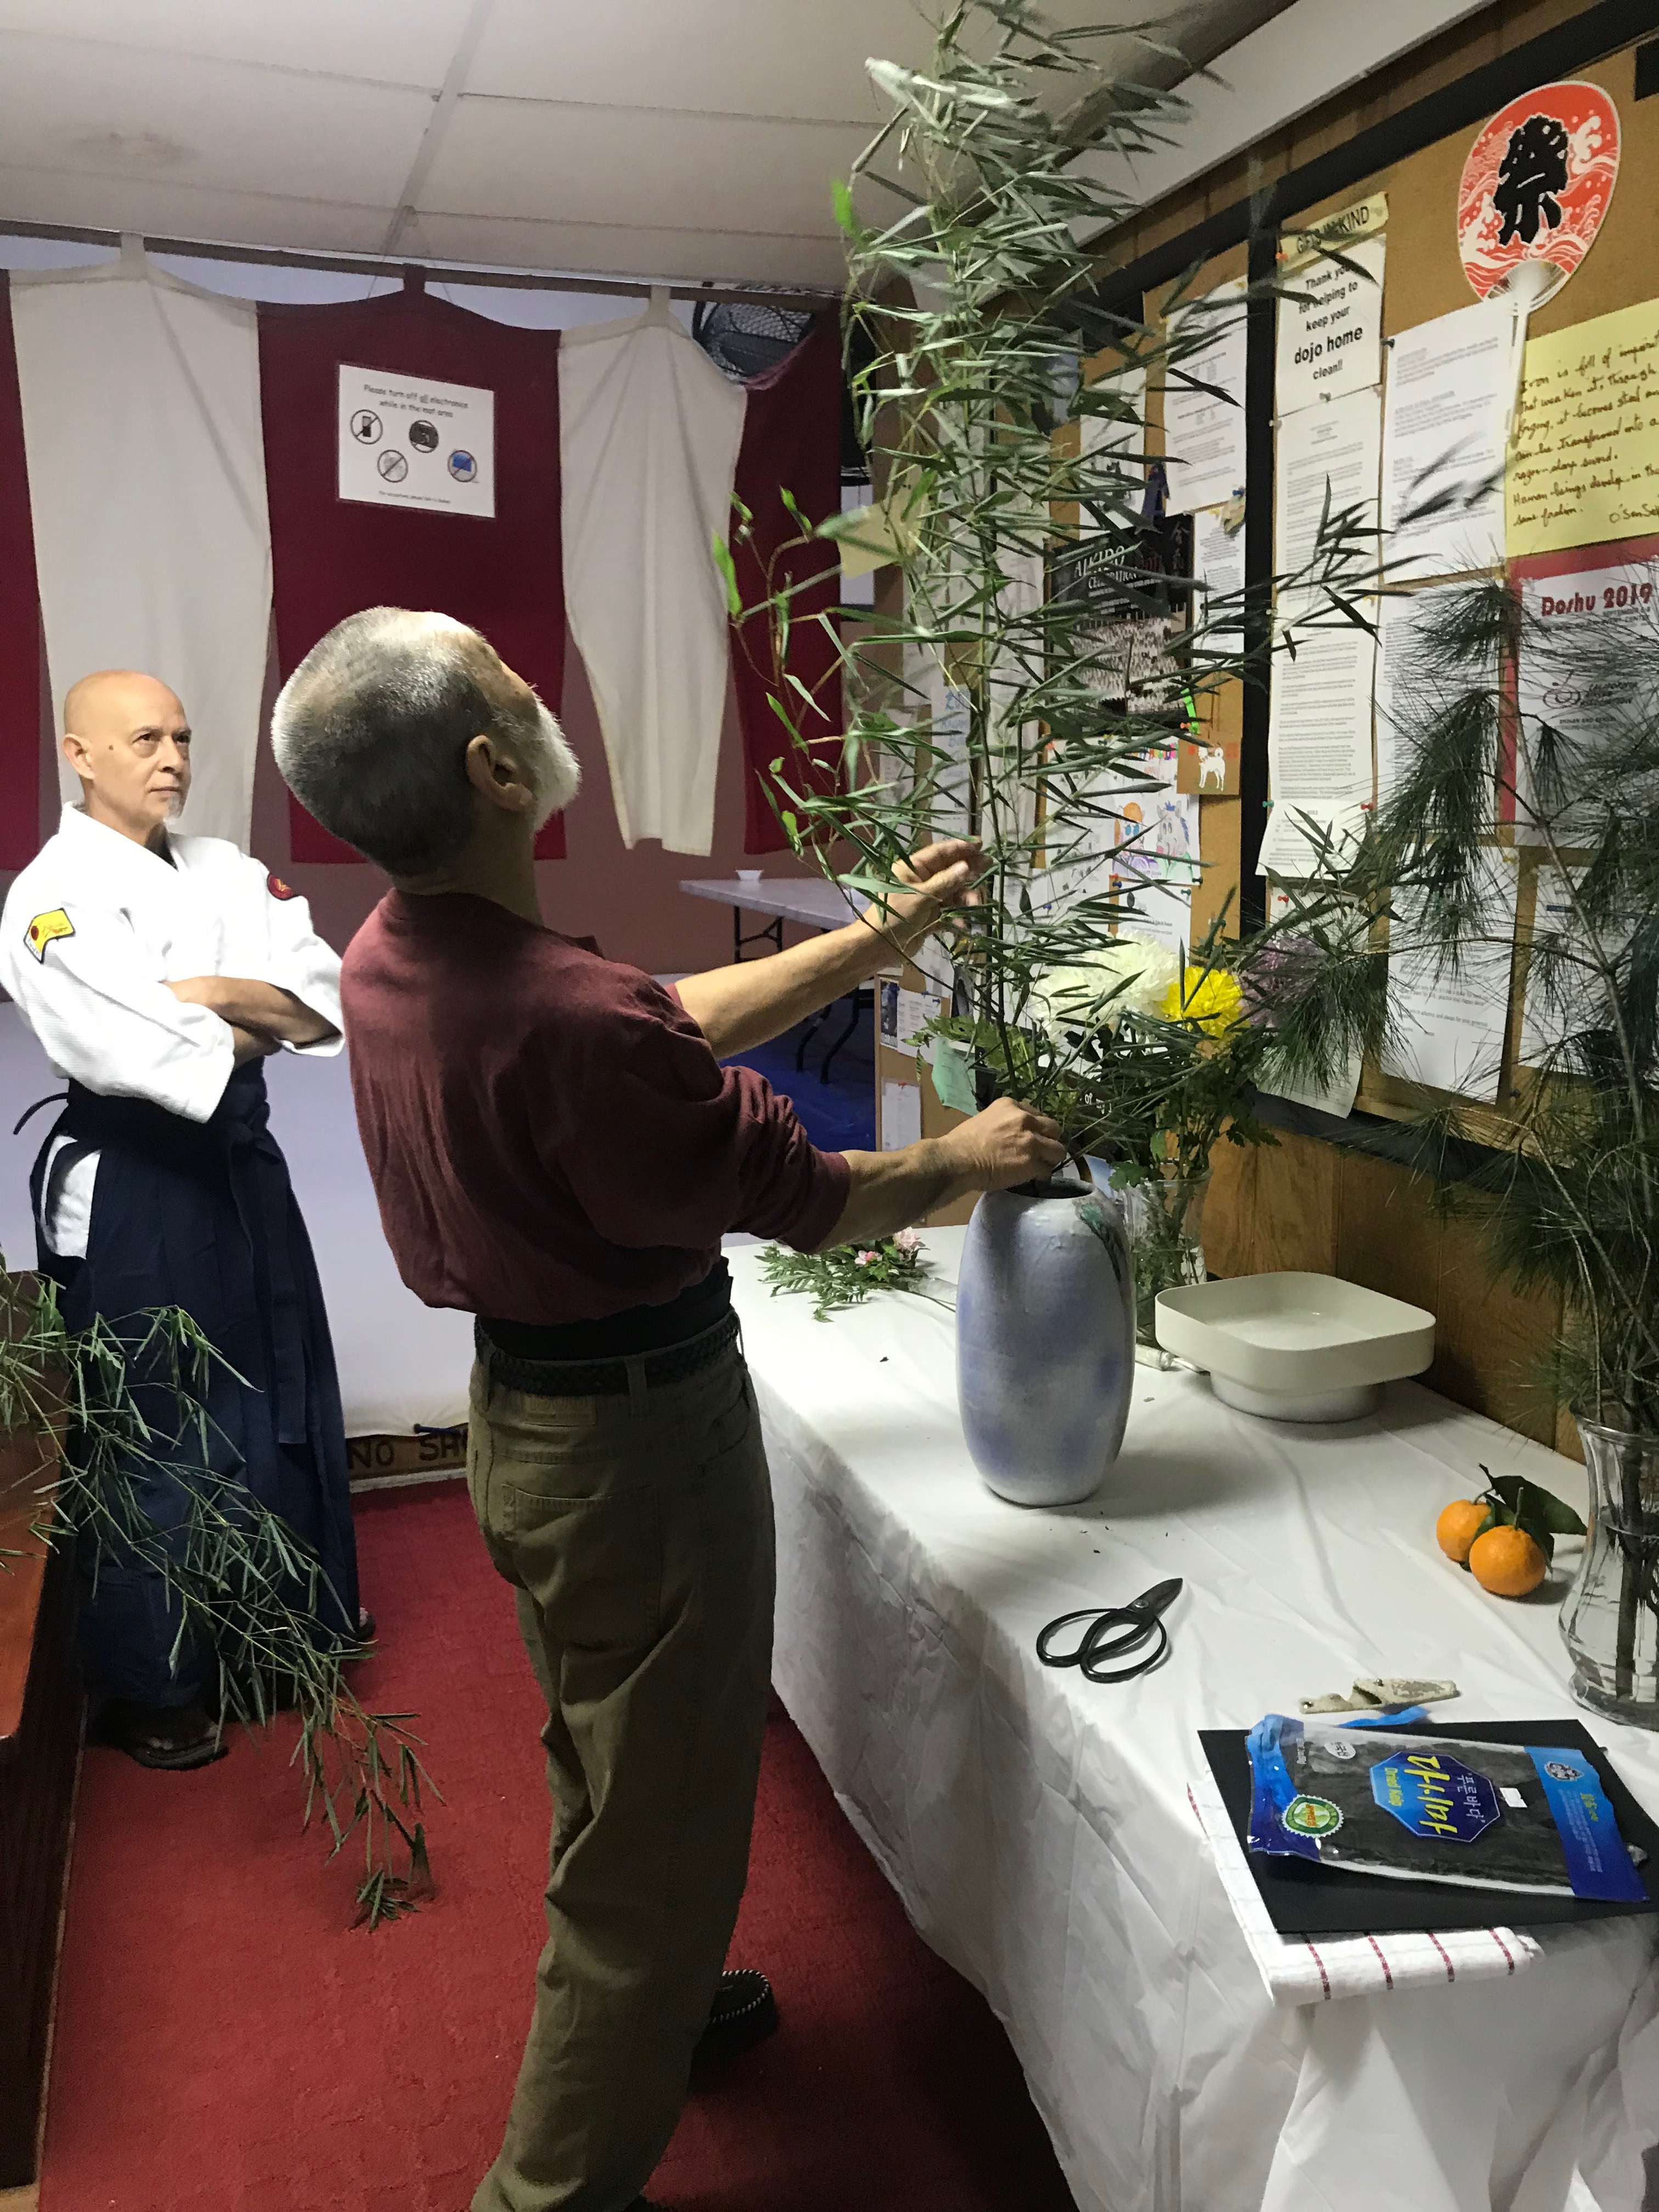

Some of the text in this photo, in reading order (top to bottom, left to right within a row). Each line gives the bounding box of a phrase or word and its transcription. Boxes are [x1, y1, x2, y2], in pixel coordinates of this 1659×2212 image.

[1306, 269, 1332, 290] Thank
[1313, 287, 1345, 308] lping
[1348, 281, 1358, 292] to
[1306, 306, 1350, 331] keep your
[1294, 327, 1363, 364] dojo home
[364, 384, 386, 395] Please
[1513, 493, 1548, 507] Human
[1542, 591, 1596, 616] Doshu
[1604, 582, 1653, 609] 2019
[347, 1438, 394, 1469] NO
[1403, 1755, 1458, 1835] 다시마
